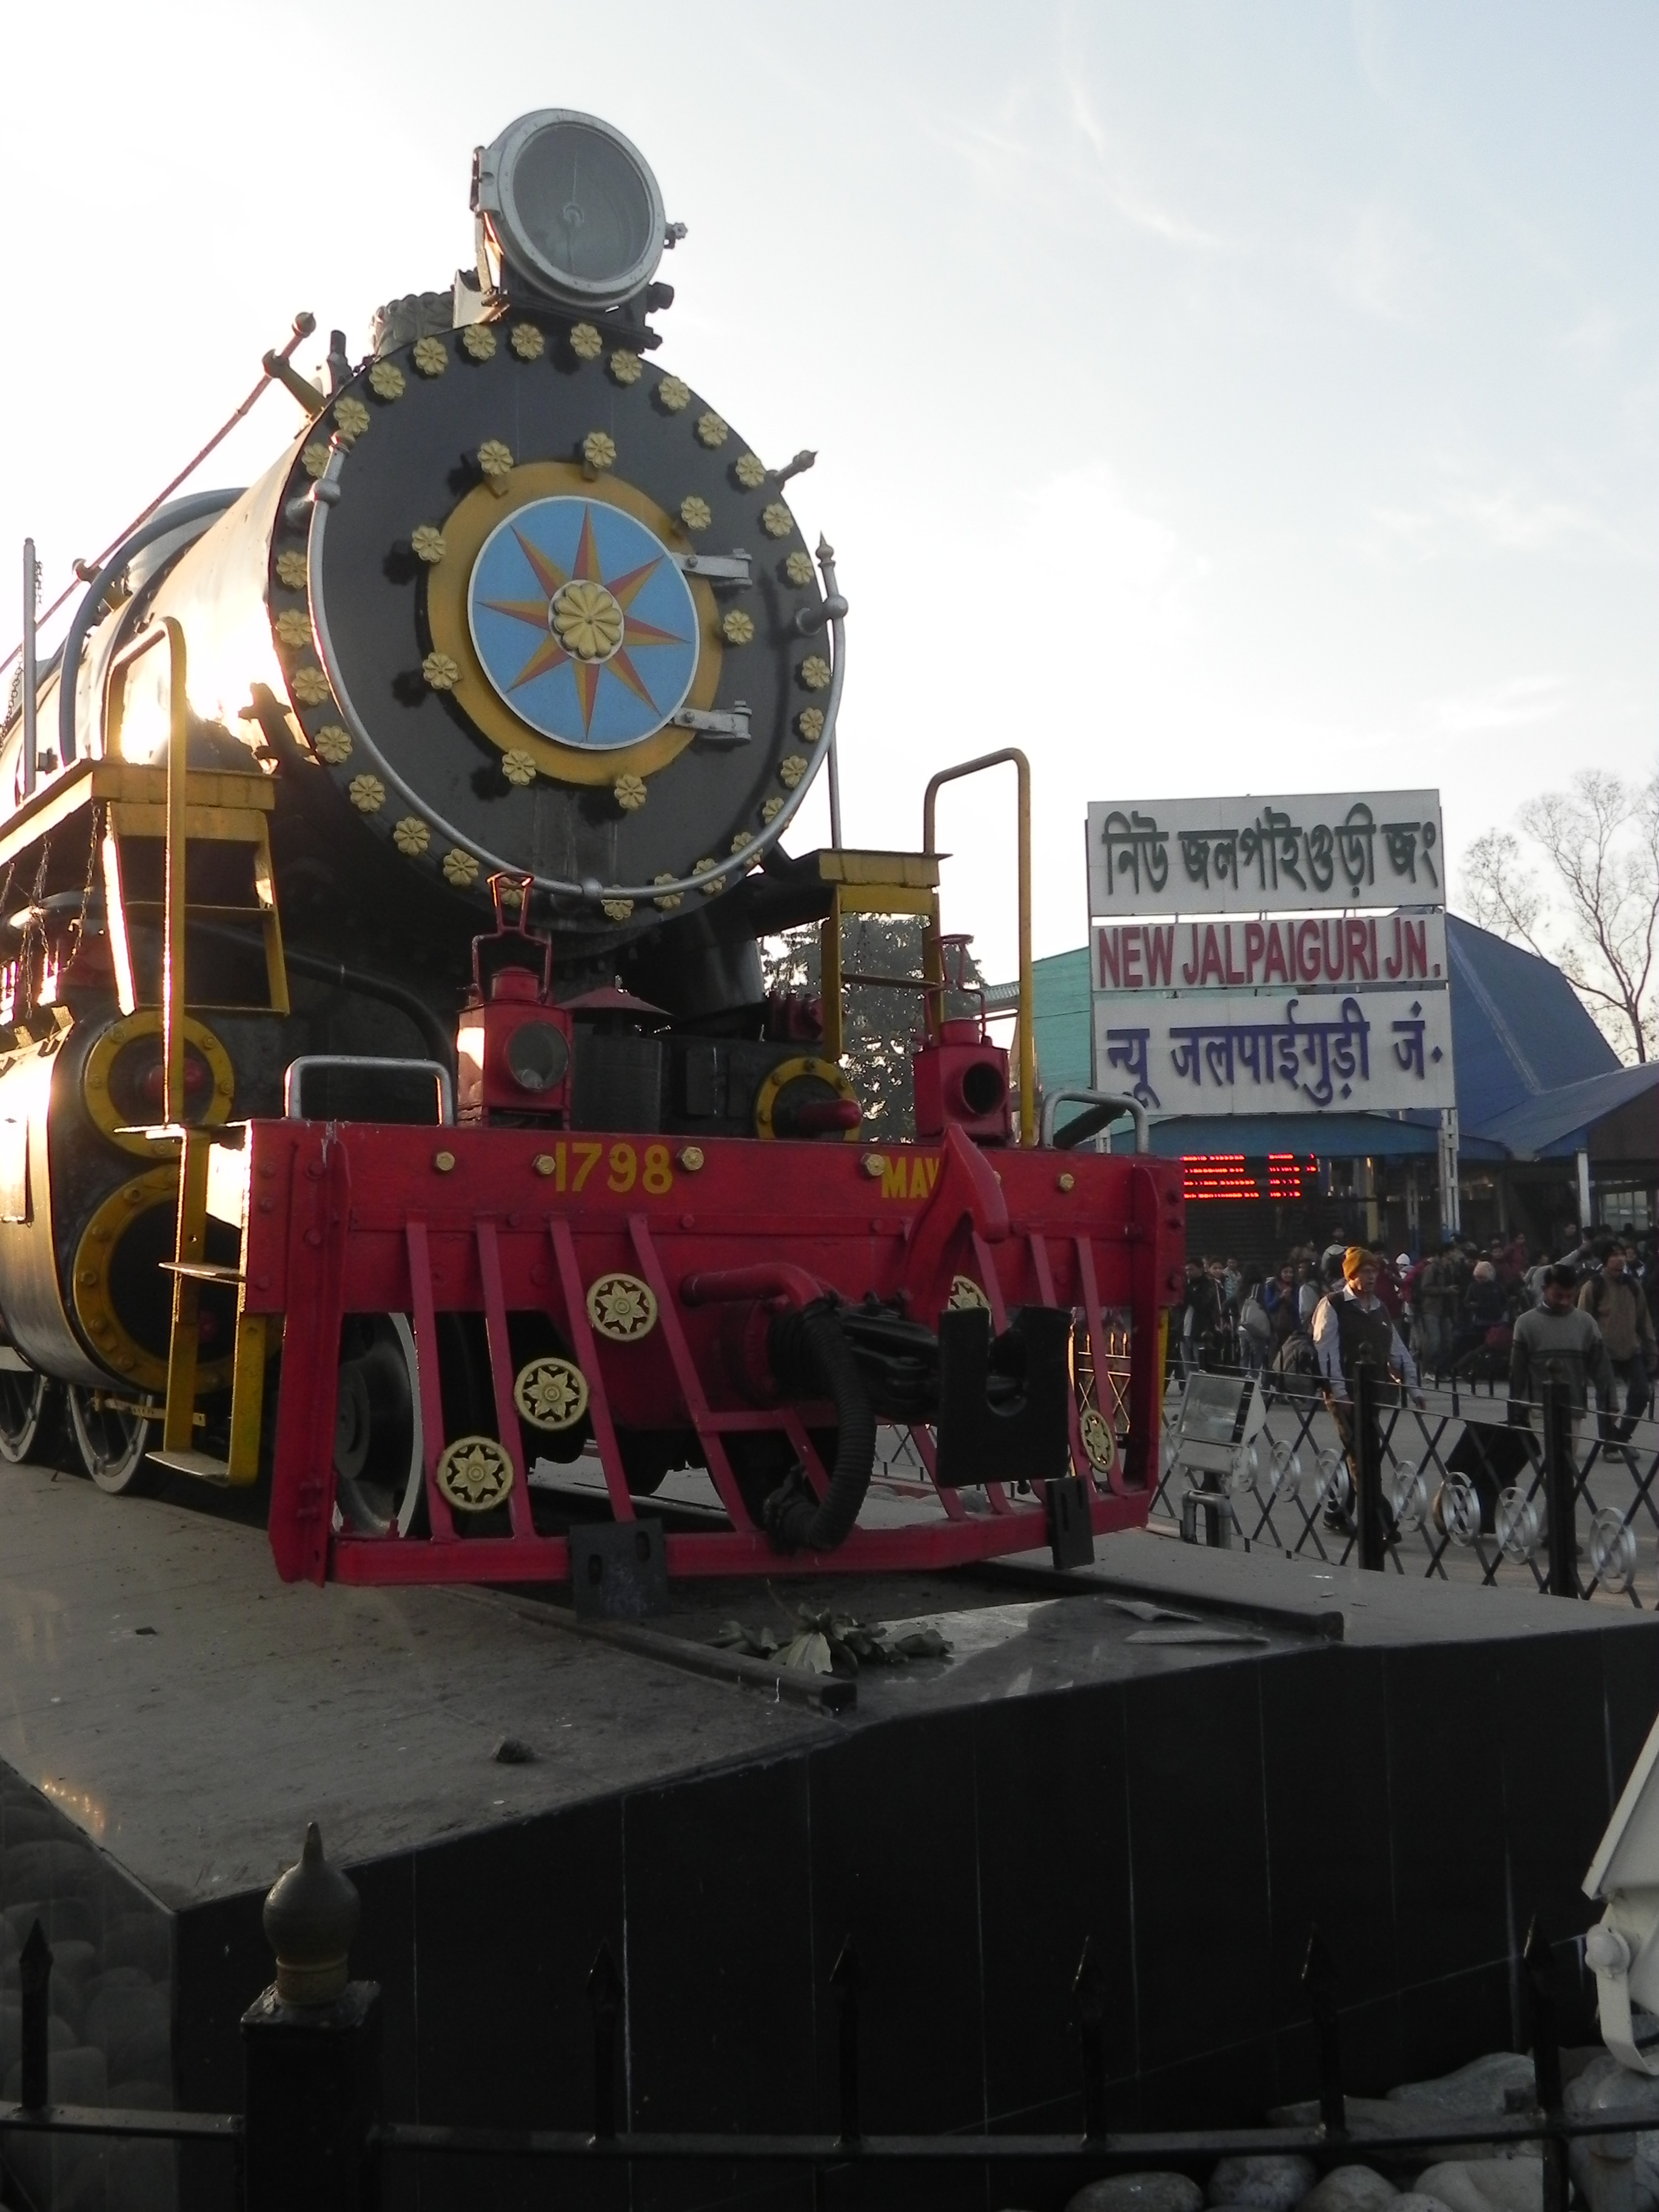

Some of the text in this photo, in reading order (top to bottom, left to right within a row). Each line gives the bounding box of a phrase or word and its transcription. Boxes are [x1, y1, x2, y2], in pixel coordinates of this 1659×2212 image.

[1101, 810, 1170, 895] নিউ
[1381, 821, 1439, 889] জং
[1098, 916, 1441, 988] NEW JALPAIGURI JN.
[1107, 1028, 1161, 1108] न्यू
[555, 1141, 674, 1194] 1798
